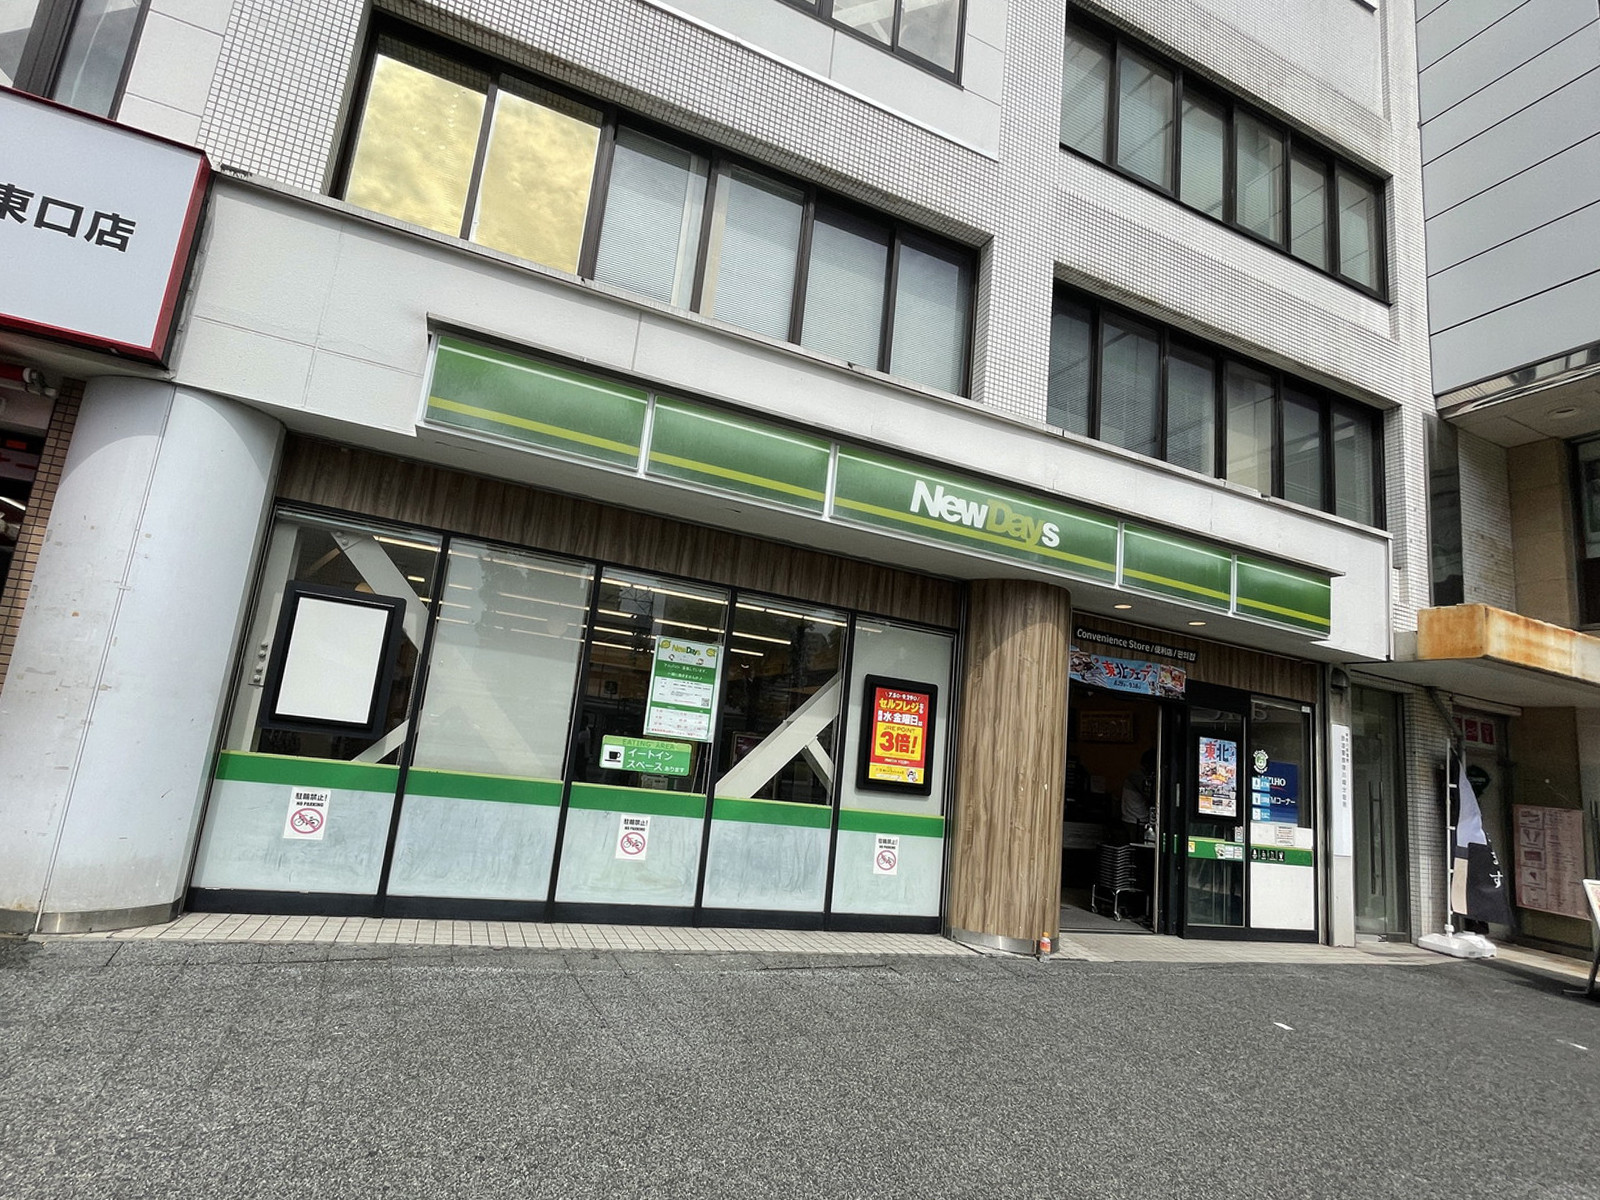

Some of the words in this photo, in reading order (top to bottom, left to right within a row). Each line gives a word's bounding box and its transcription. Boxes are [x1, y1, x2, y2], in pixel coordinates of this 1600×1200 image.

[0, 183, 136, 252] 東口店
[909, 480, 1060, 548] NewDays
[1077, 628, 1127, 647] Convenience
[1128, 639, 1150, 651] Store
[672, 644, 701, 656] NewDays
[879, 698, 920, 713] セルフレジ
[628, 748, 673, 761] イートイン
